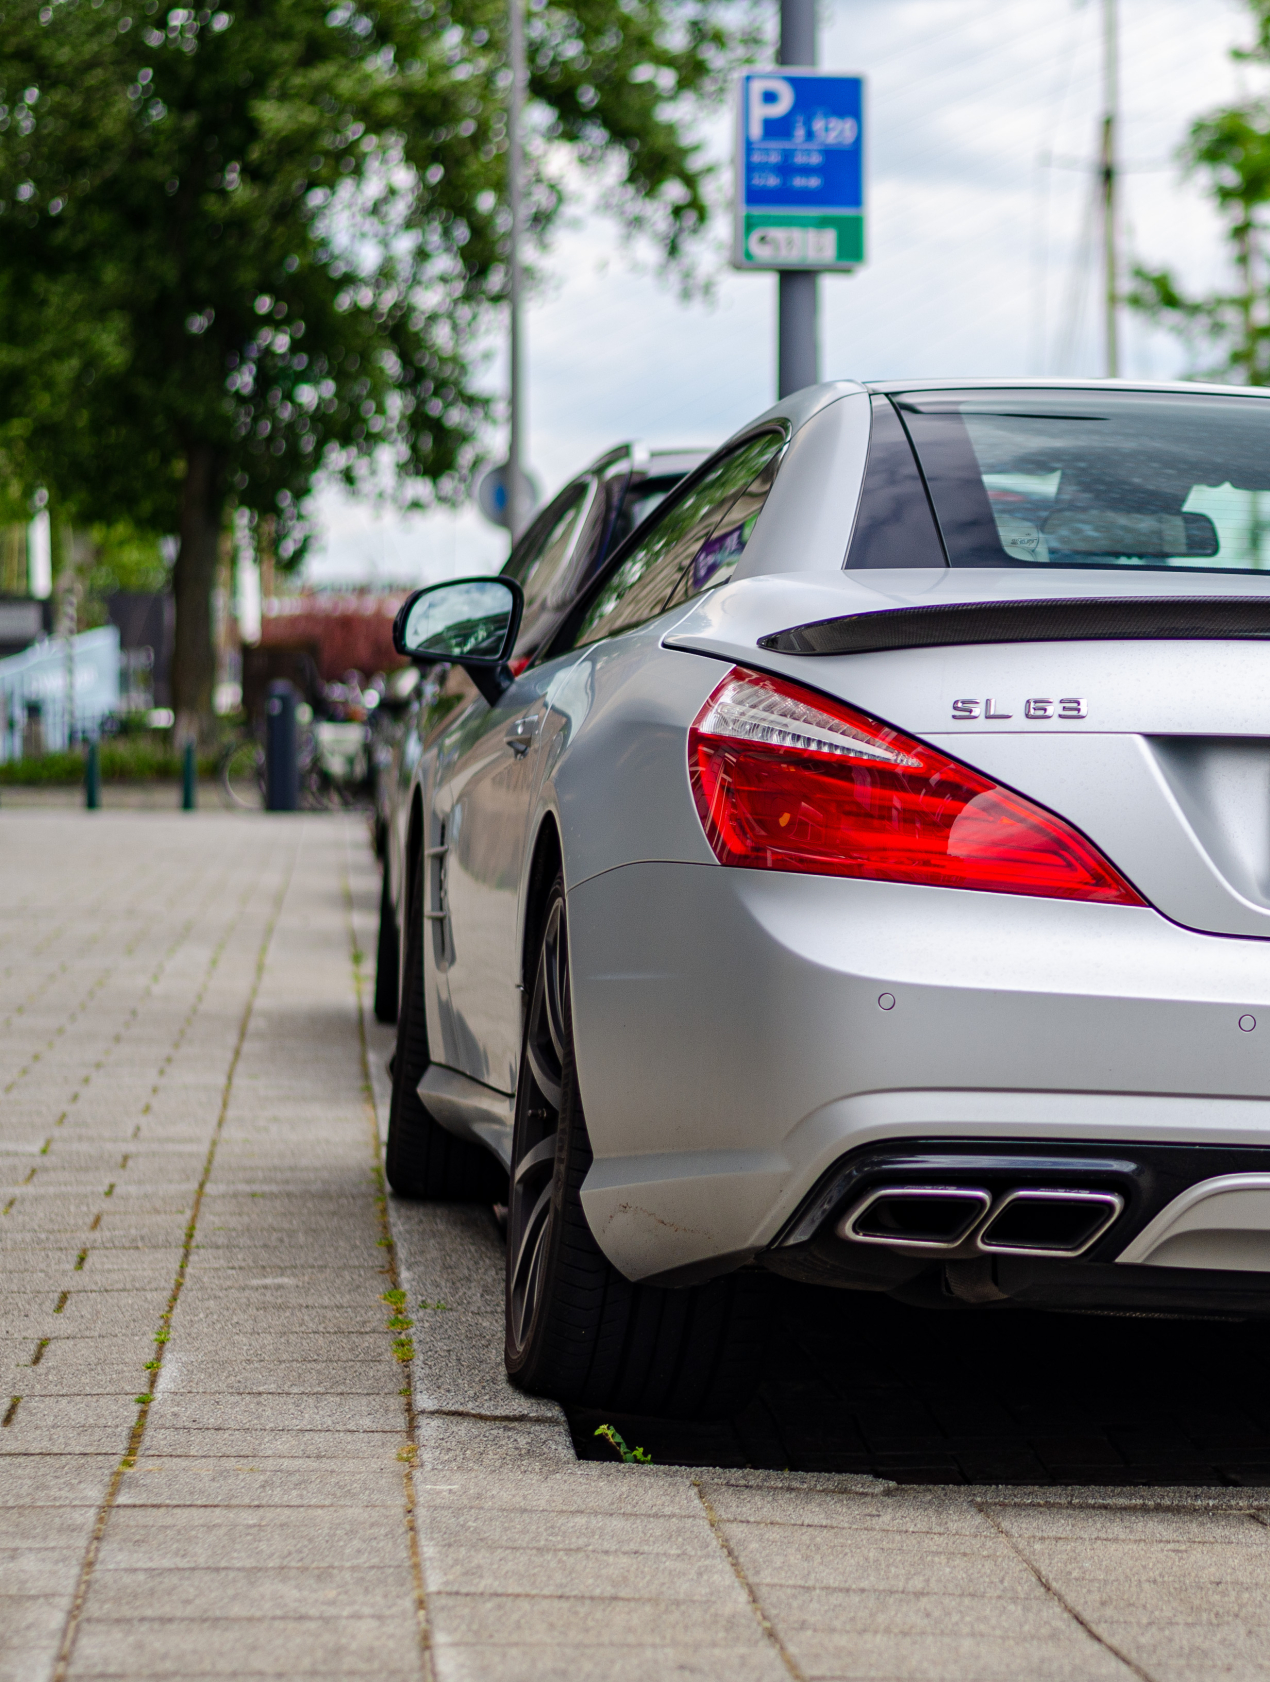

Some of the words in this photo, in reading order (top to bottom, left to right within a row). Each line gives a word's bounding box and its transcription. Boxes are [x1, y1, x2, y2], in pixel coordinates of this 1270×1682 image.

[748, 77, 796, 142] P
[952, 699, 1013, 720] SL
[1025, 698, 1088, 720] 63
